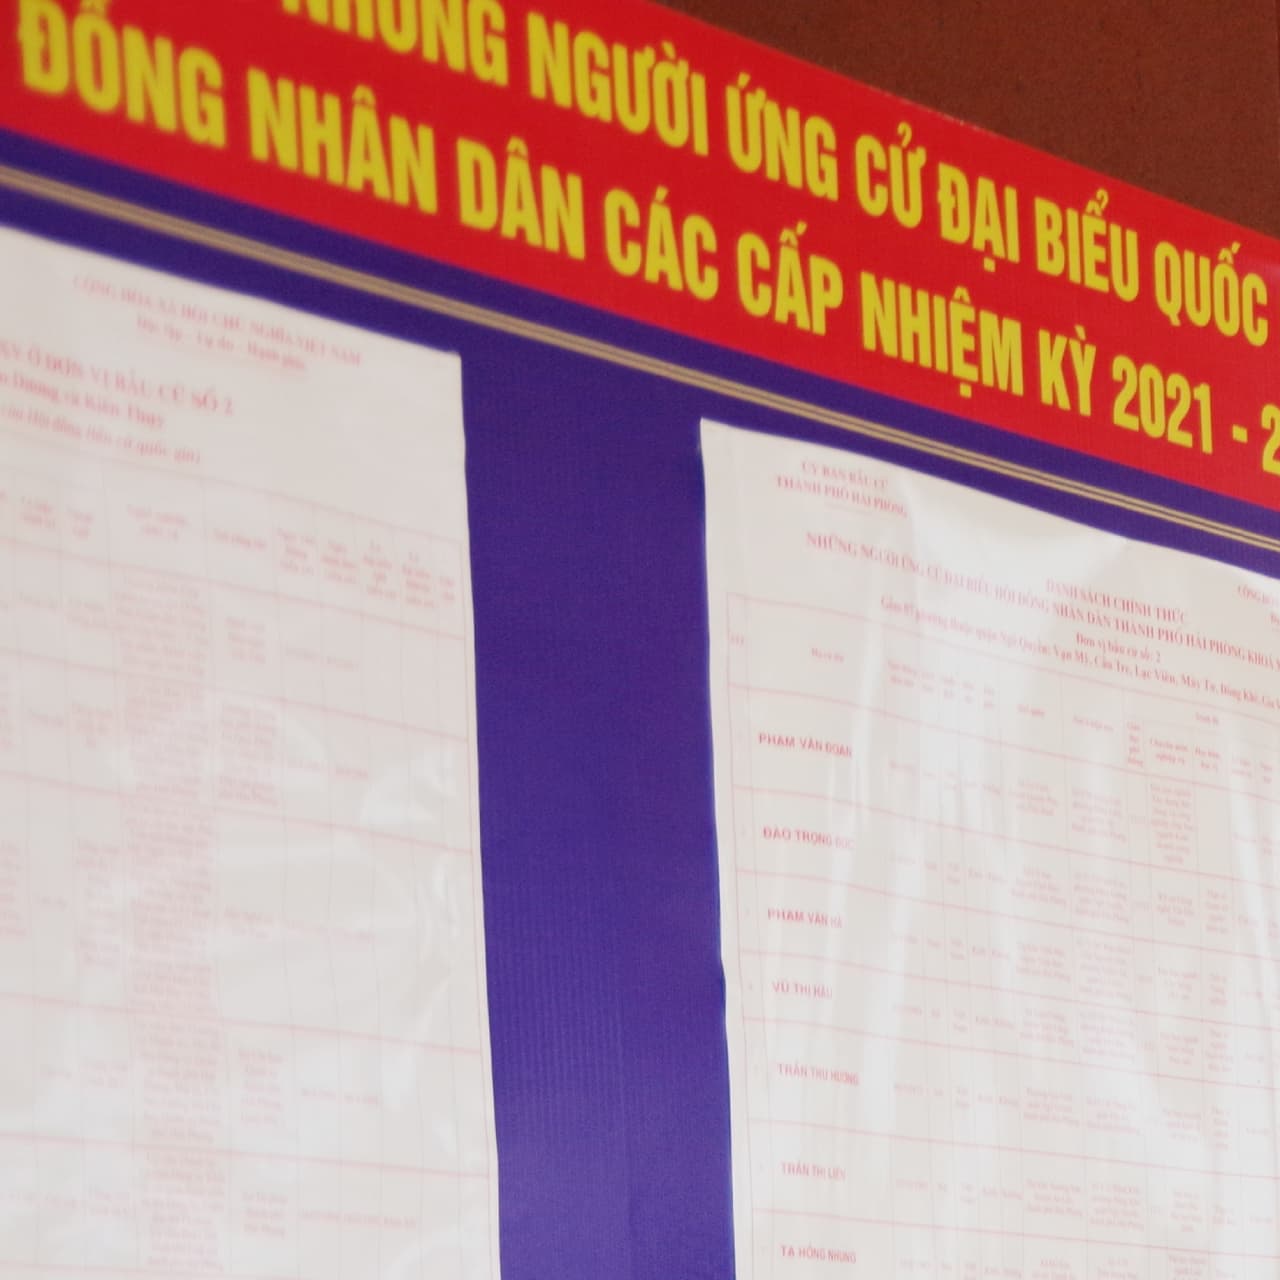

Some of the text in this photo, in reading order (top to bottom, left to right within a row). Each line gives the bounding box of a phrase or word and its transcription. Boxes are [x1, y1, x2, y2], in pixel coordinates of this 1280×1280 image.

[246, 66, 438, 215] NHÂN
[456, 136, 585, 261] DÂN
[604, 186, 718, 301] CÁC
[737, 222, 844, 335] CẤP
[860, 270, 1024, 400] NHIỆM
[1038, 322, 1094, 418] KỲ
[1112, 354, 1213, 453] 2021
[1233, 424, 1247, 442] -
[527, 12, 709, 157] NGƯỜI
[725, 72, 839, 202] ỨNG
[854, 121, 927, 229] CỬ
[937, 161, 1018, 272] ĐẠI
[1034, 189, 1140, 304] BIỂU
[1153, 243, 1268, 348] QUỐC
